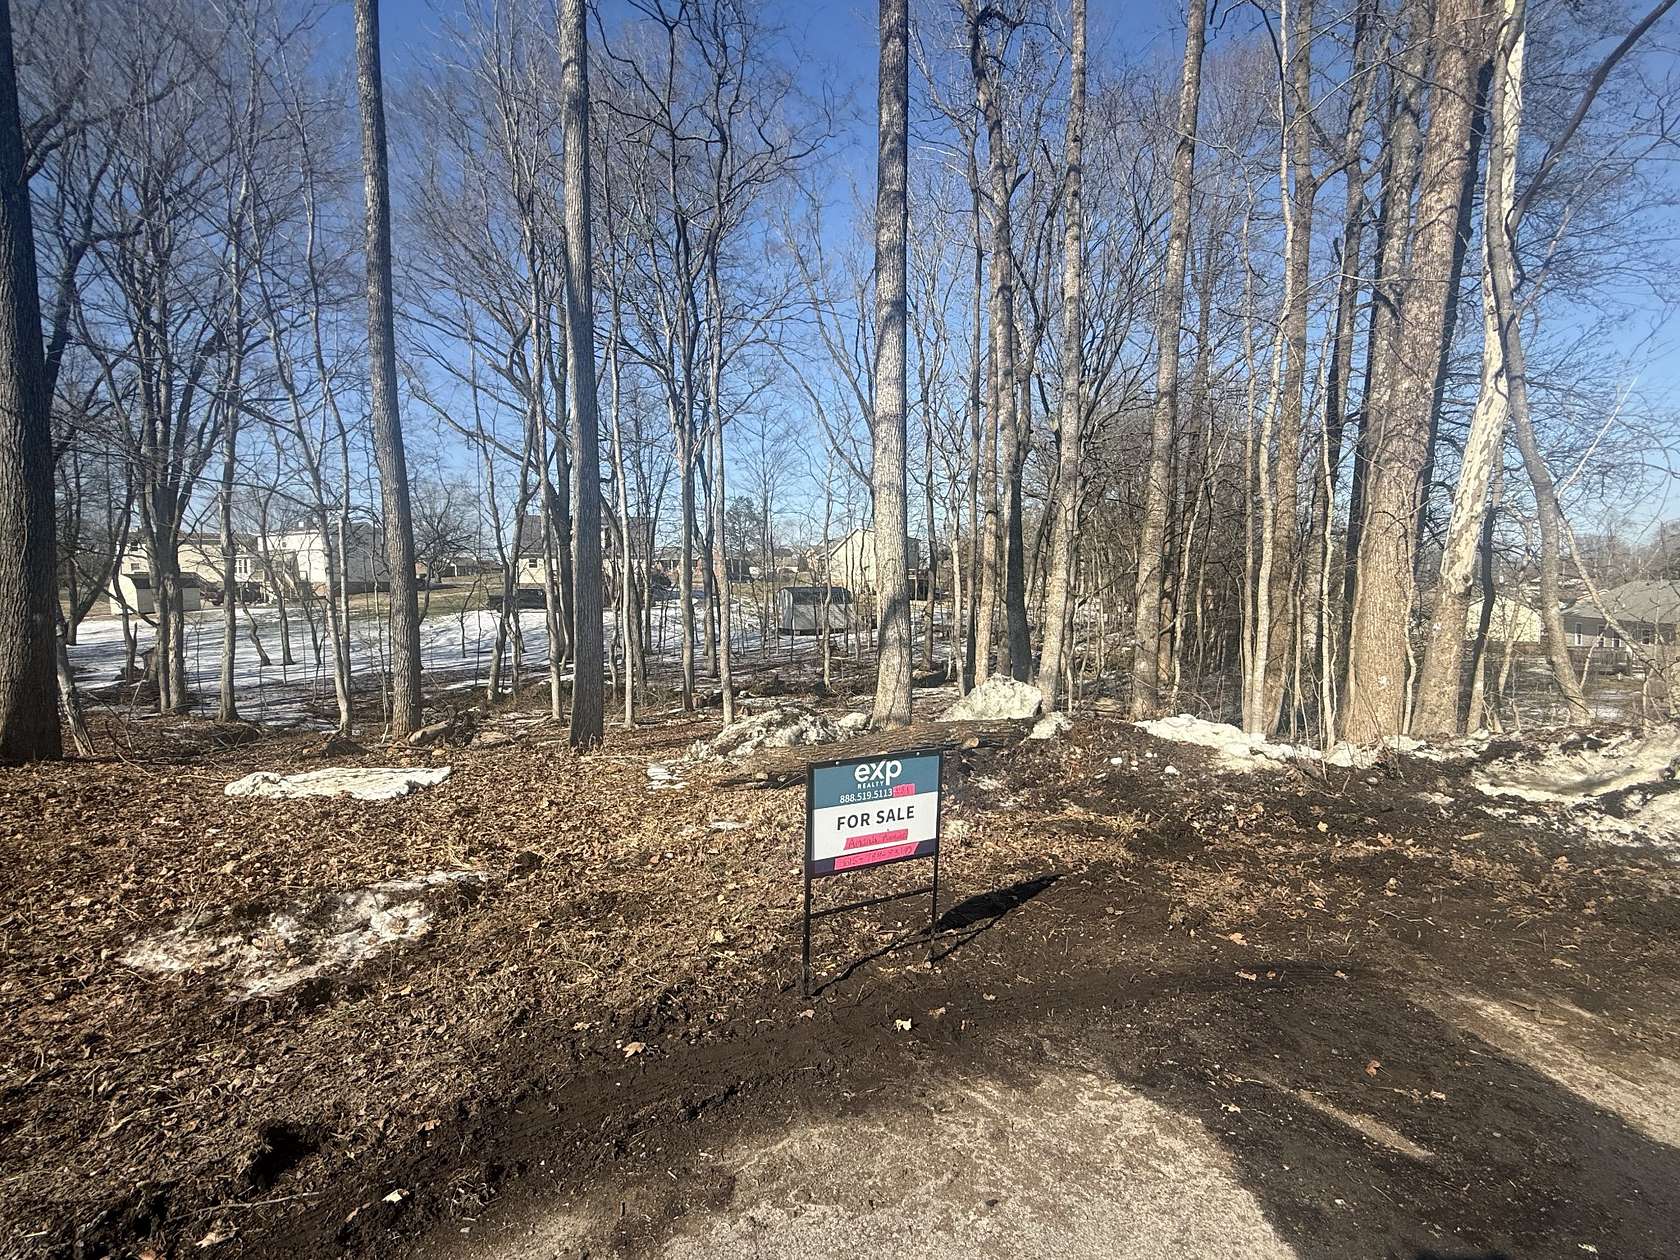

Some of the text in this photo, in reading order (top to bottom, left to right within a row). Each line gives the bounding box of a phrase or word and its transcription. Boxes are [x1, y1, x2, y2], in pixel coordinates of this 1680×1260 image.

[857, 781, 884, 789] REALTY
[839, 788, 892, 803] 888.519.5113
[837, 806, 915, 830] FOR SALE
